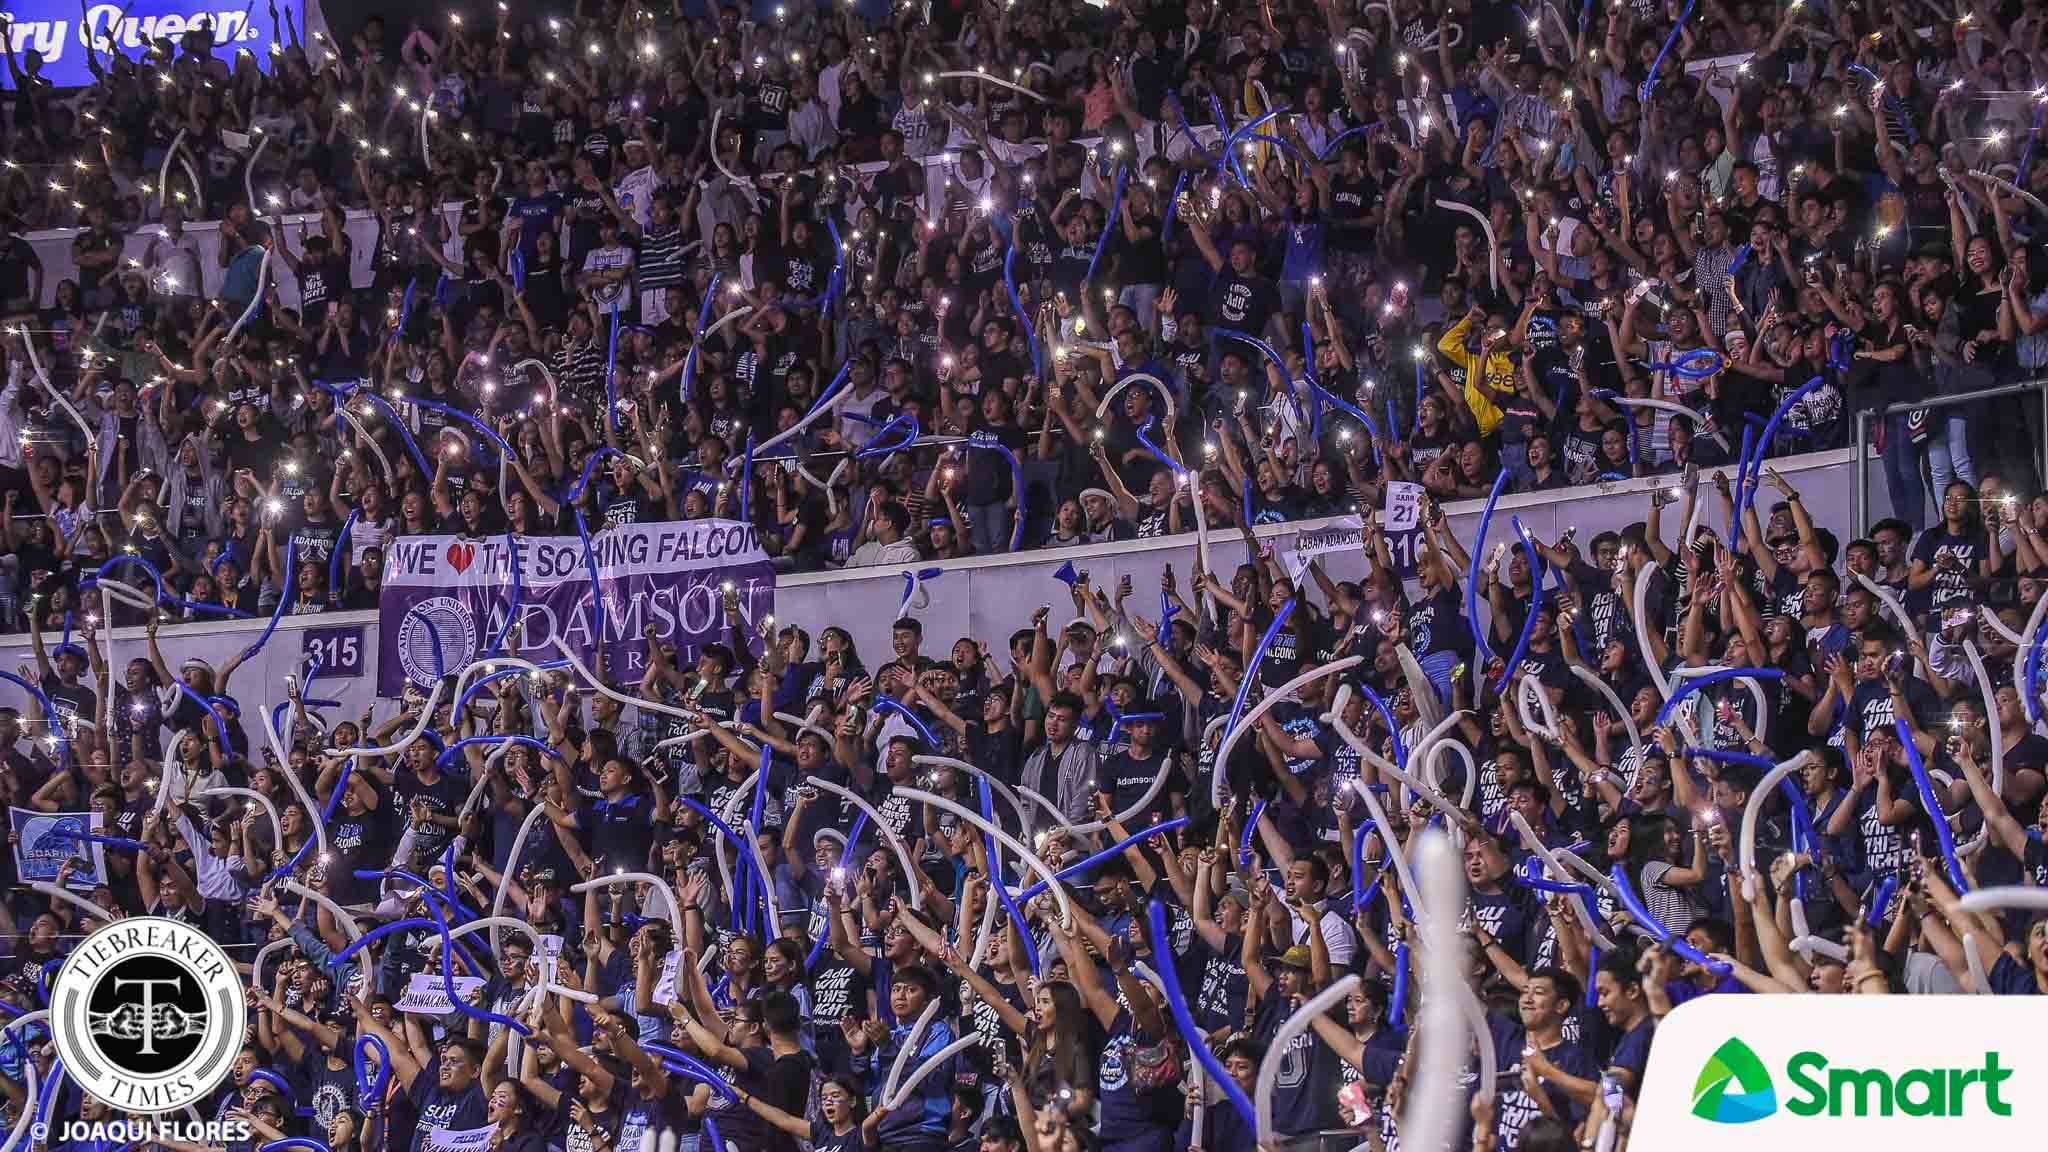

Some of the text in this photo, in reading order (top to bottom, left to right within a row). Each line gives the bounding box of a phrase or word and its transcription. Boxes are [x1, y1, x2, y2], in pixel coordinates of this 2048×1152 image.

[1394, 505, 1414, 522] 21
[395, 543, 436, 575] WE
[482, 543, 530, 574] THE
[536, 536, 648, 577] SOARING
[484, 577, 758, 653] ADAMSON
[440, 598, 476, 650] UNIVERSITY
[307, 637, 358, 667] 315
[1265, 646, 1297, 660] ALCONS
[820, 967, 855, 980] AdU
[815, 979, 849, 990] WIN
[815, 989, 849, 1003] THIS
